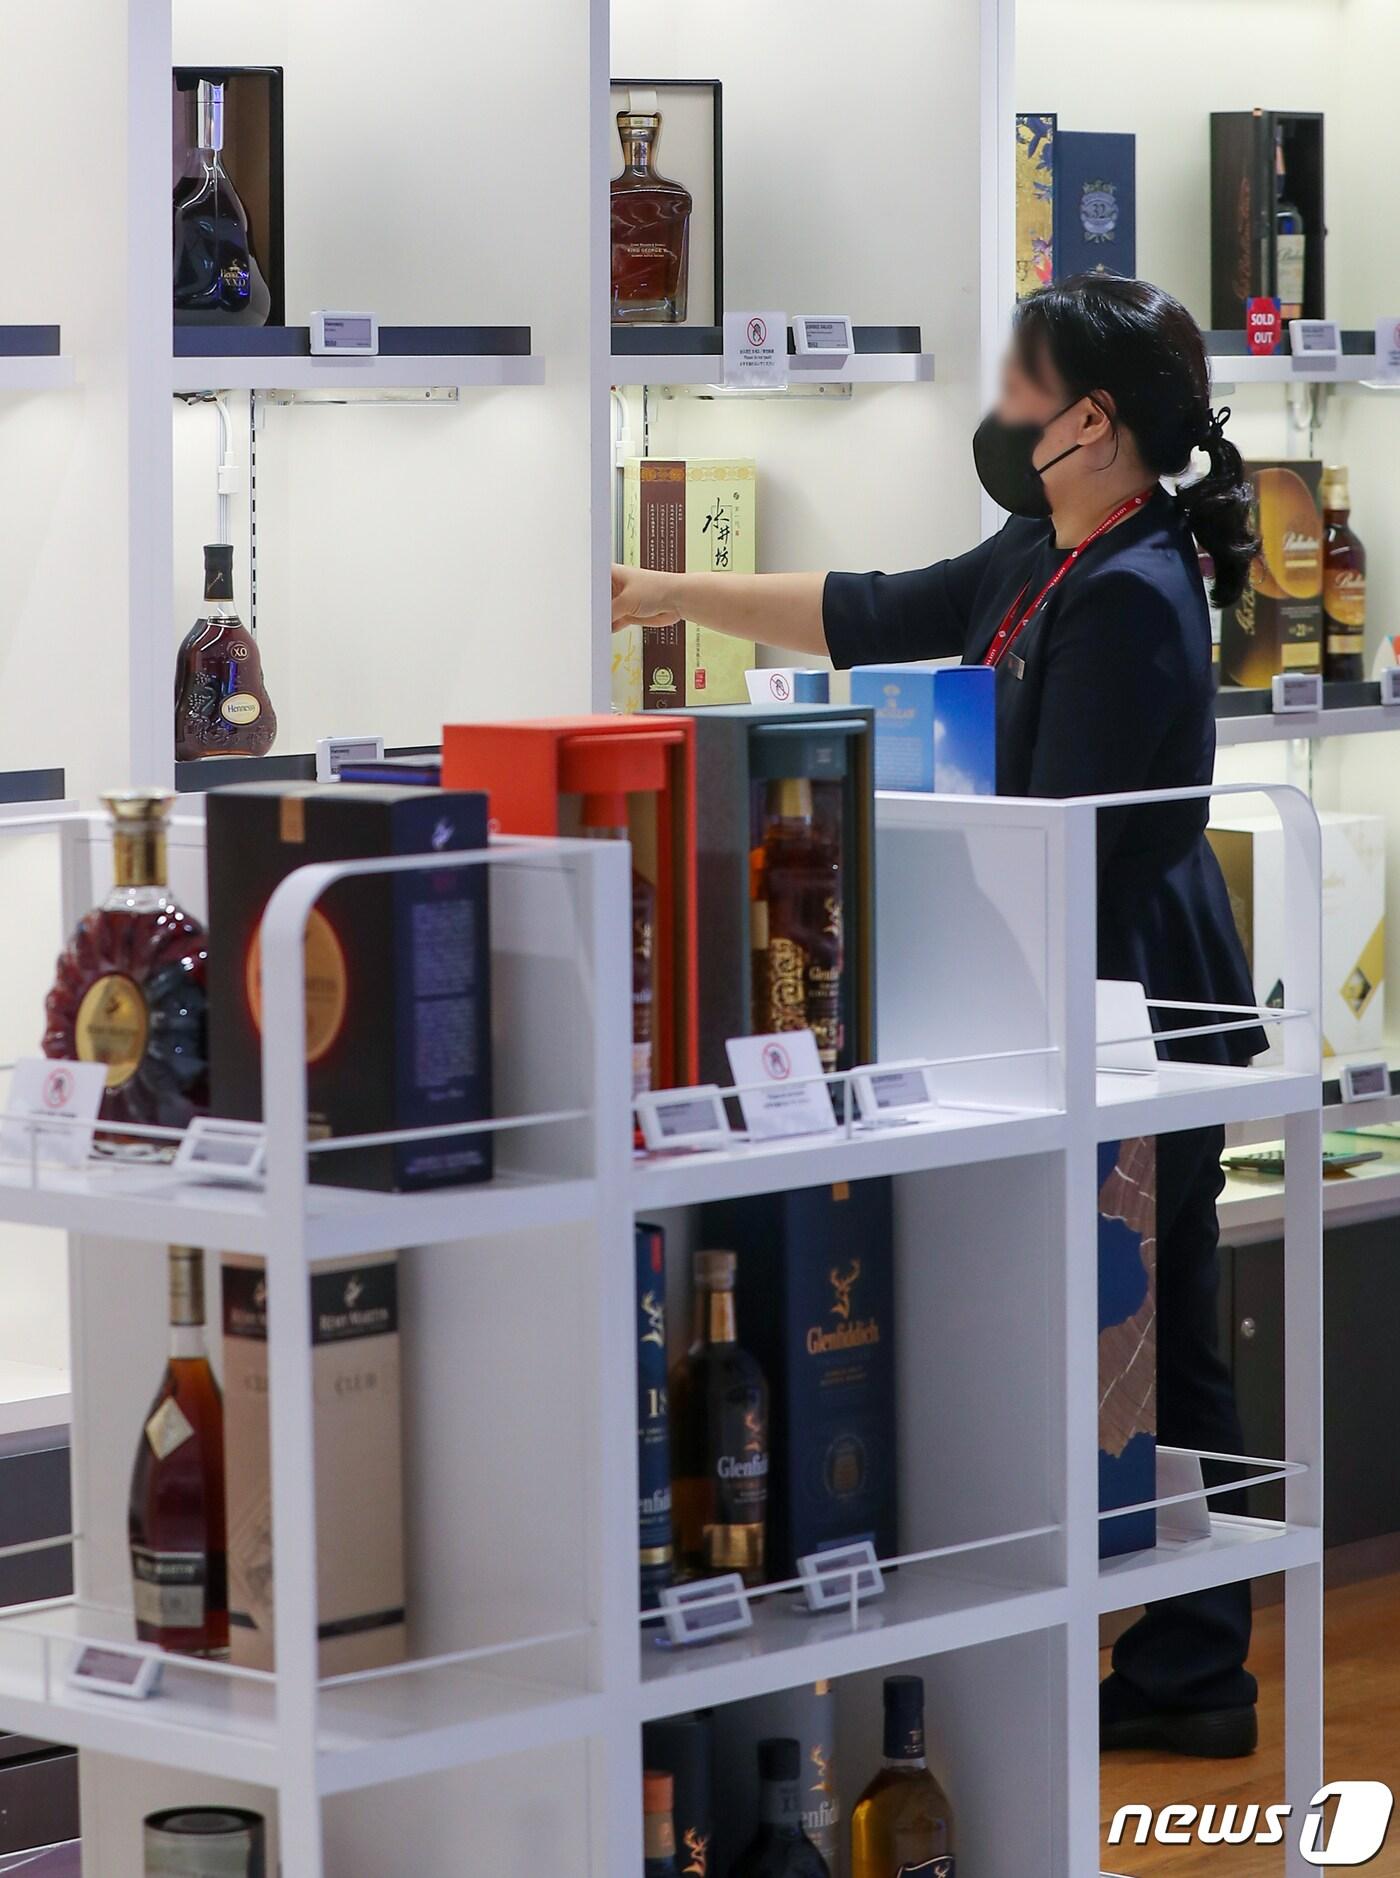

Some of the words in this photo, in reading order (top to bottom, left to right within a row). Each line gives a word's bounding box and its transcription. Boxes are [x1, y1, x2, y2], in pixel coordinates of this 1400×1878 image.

[1251, 313, 1275, 326] SOLD
[1254, 331, 1274, 344] OUT
[702, 497, 730, 568] 水井坊
[233, 647, 248, 657] XO
[806, 1317, 880, 1356] Glenfiddich
